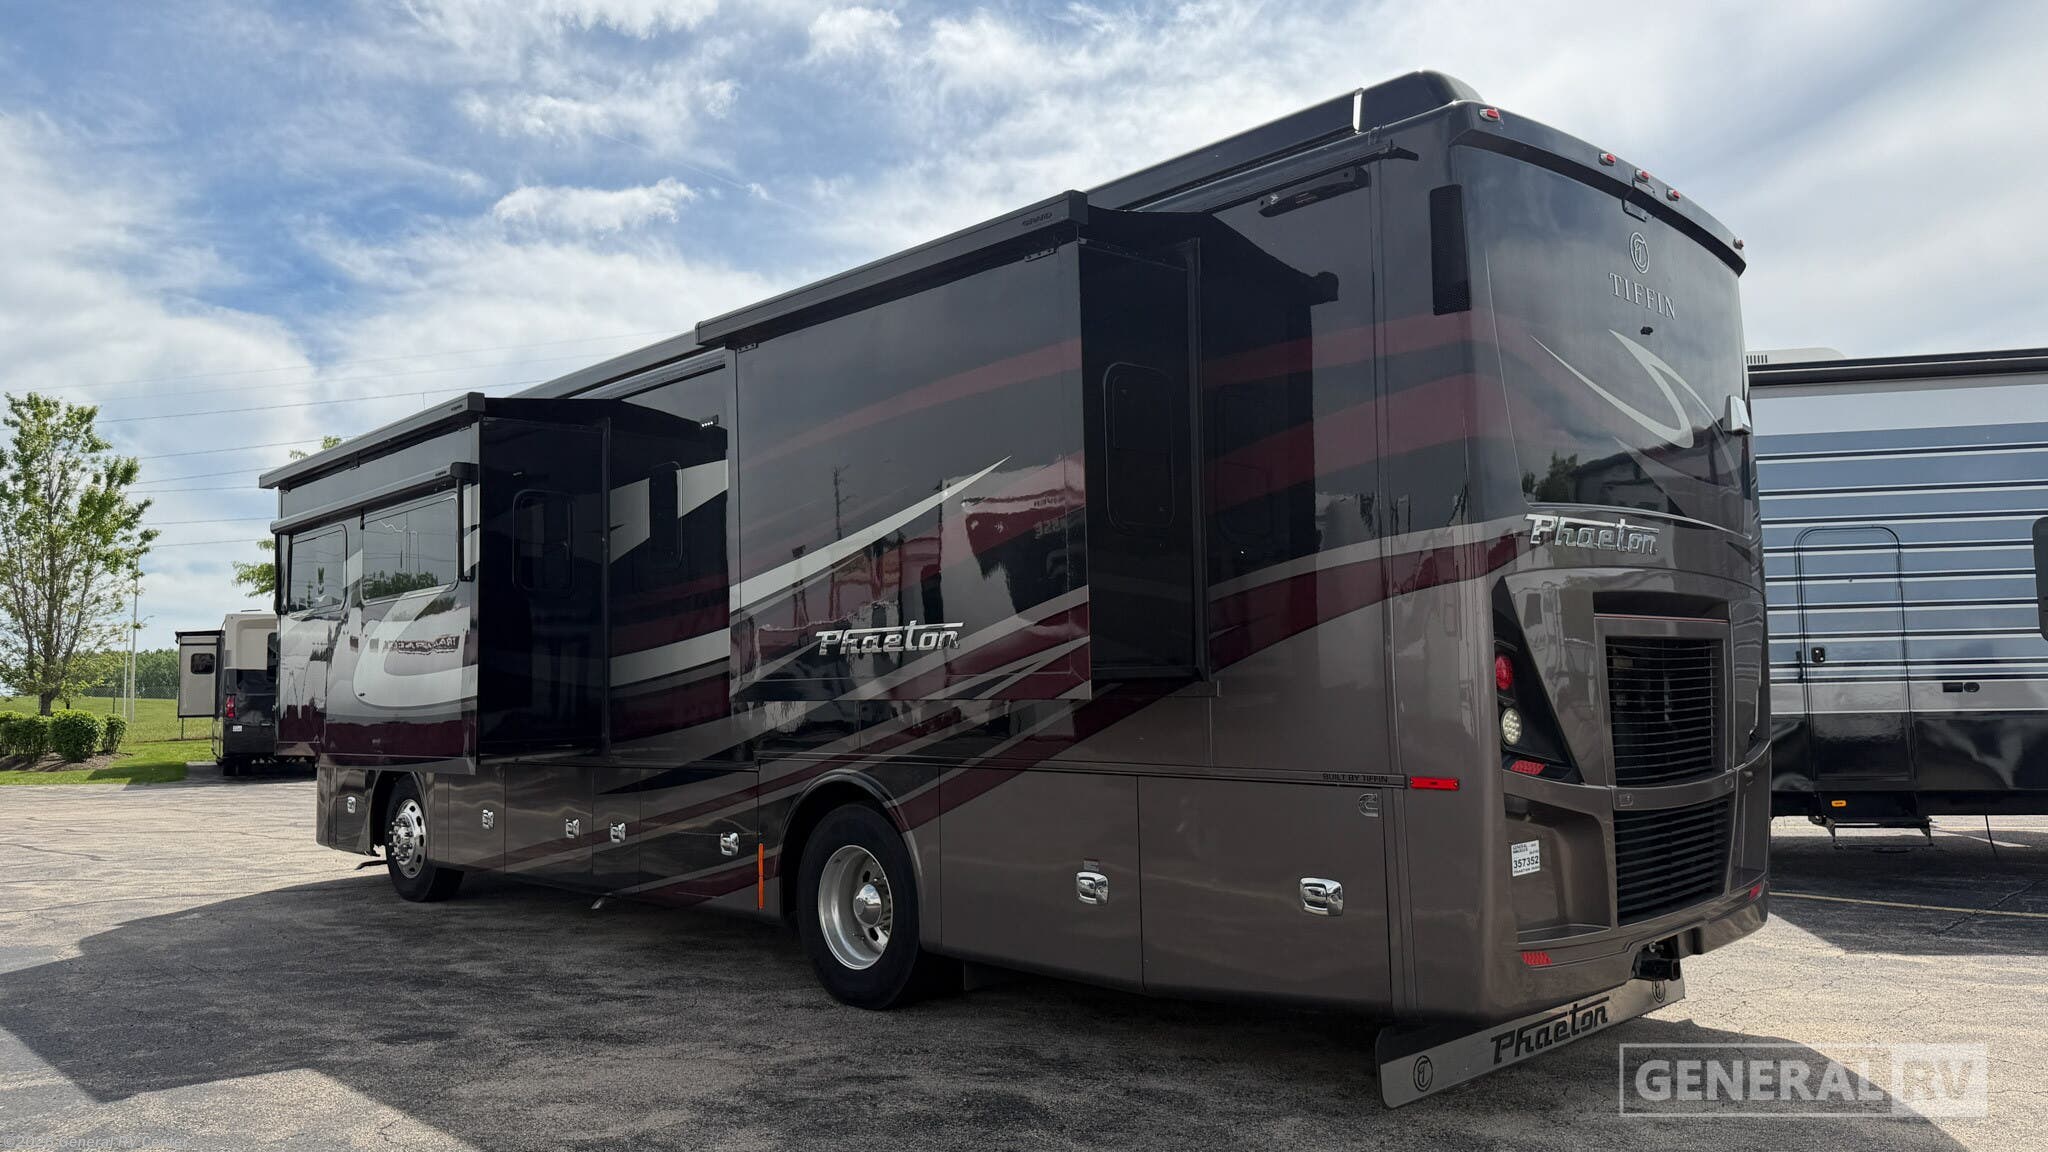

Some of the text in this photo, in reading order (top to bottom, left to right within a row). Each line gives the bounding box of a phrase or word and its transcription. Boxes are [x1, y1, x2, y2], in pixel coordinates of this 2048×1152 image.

[1608, 271, 1675, 320] TIFFIN
[1525, 513, 1660, 554] Phaeton
[815, 620, 964, 655] Phaeton
[1322, 773, 1346, 781] BUILT
[1362, 775, 1388, 783] TIFFIN
[1513, 855, 1539, 869] 357352
[1490, 996, 1610, 1065] Phaeton
